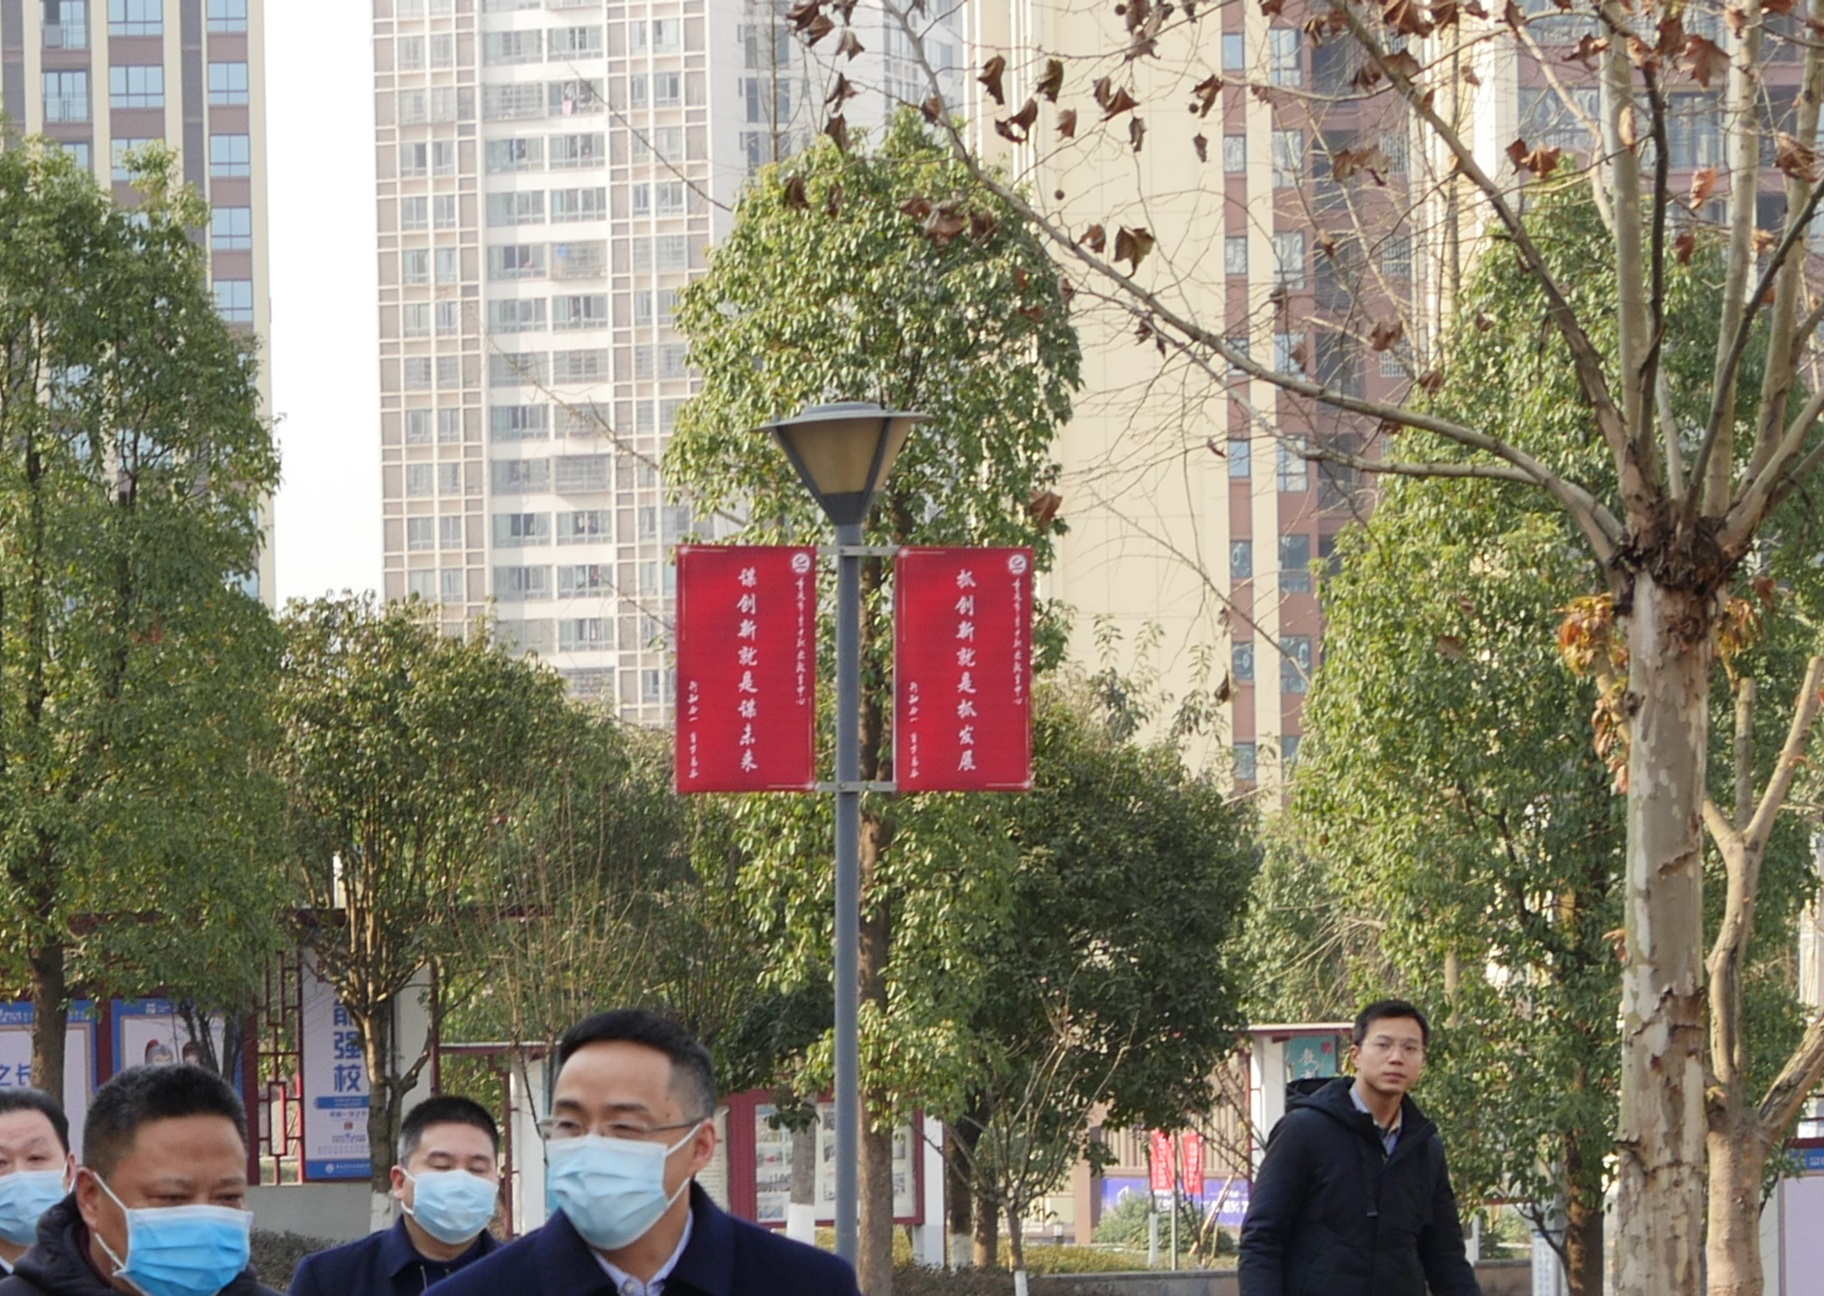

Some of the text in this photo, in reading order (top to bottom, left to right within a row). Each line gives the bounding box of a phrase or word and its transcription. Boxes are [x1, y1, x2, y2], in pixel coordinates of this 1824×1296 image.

[737, 566, 758, 772] 谋创新就是谋未来
[955, 569, 977, 771] 抓创新就是抓发展
